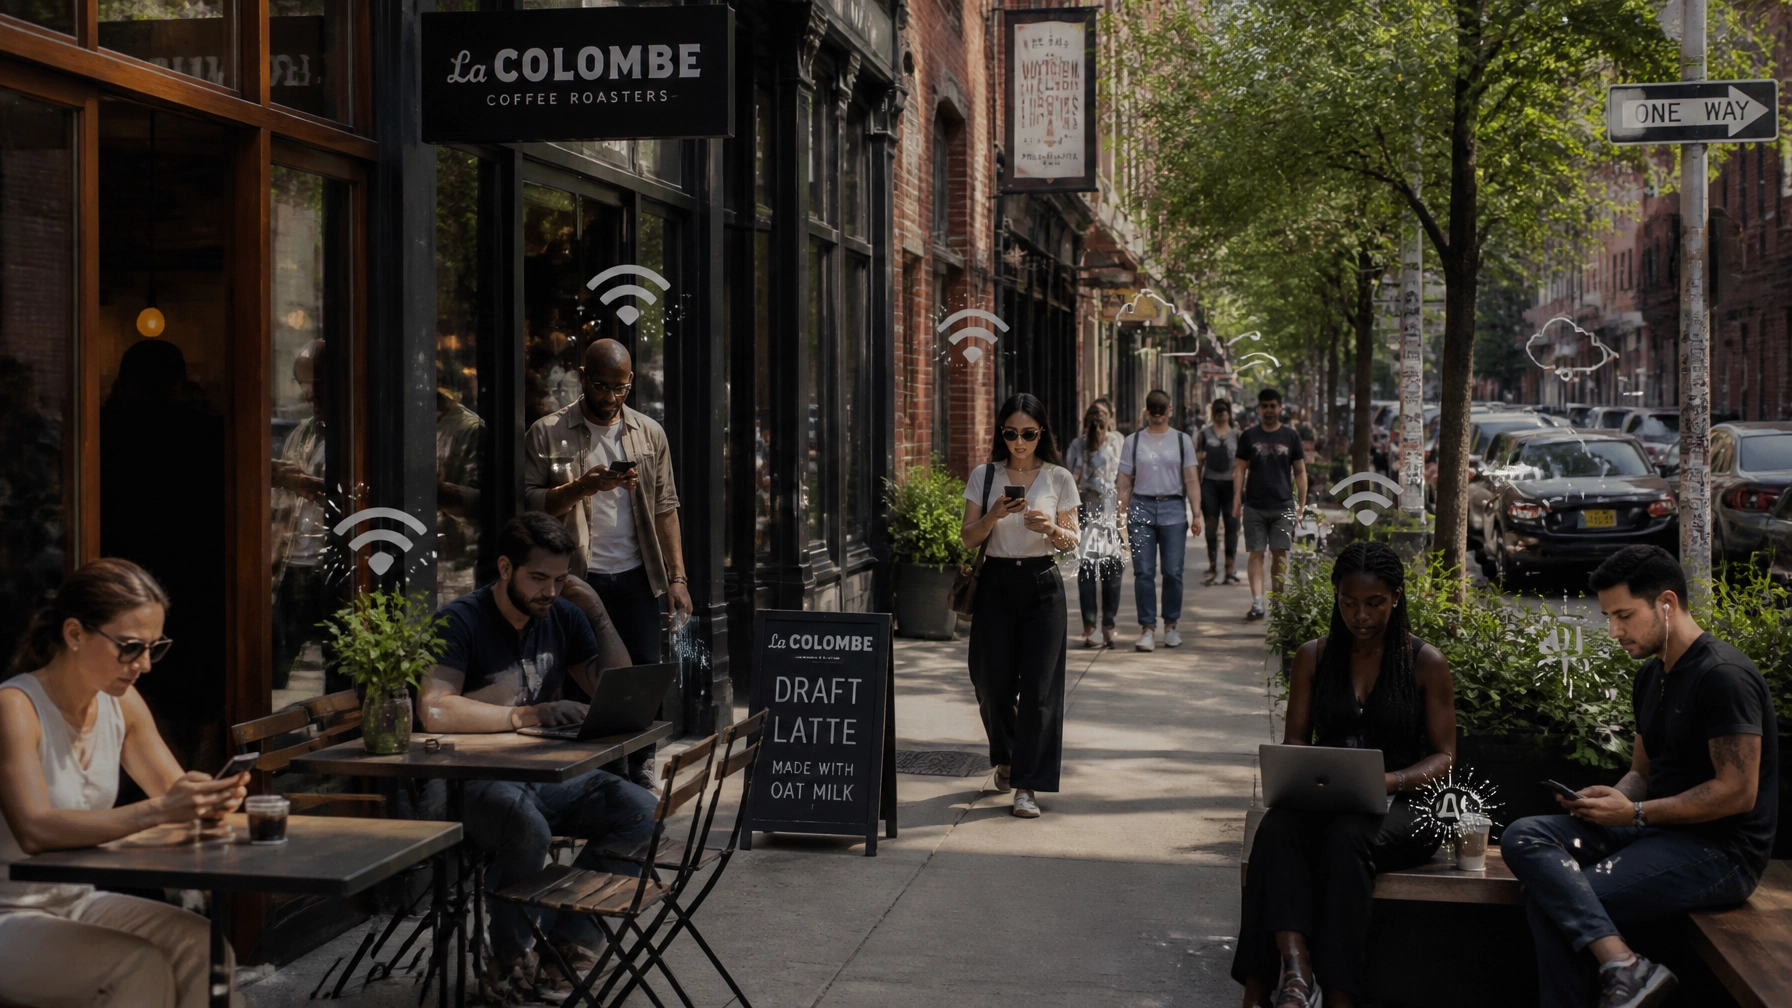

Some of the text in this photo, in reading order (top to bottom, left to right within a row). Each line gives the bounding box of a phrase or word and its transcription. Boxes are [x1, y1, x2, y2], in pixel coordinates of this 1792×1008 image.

[447, 43, 702, 83] La COLOMBE
[486, 90, 668, 106] COFFEE ROASTERS
[1635, 100, 1751, 124] ONE WAY
[768, 633, 873, 652] La COLOMBE
[775, 676, 863, 705] DRAFT
[773, 715, 857, 745] LATTE
[772, 760, 854, 777] MADE WITH
[770, 781, 854, 802] OAT MILK
